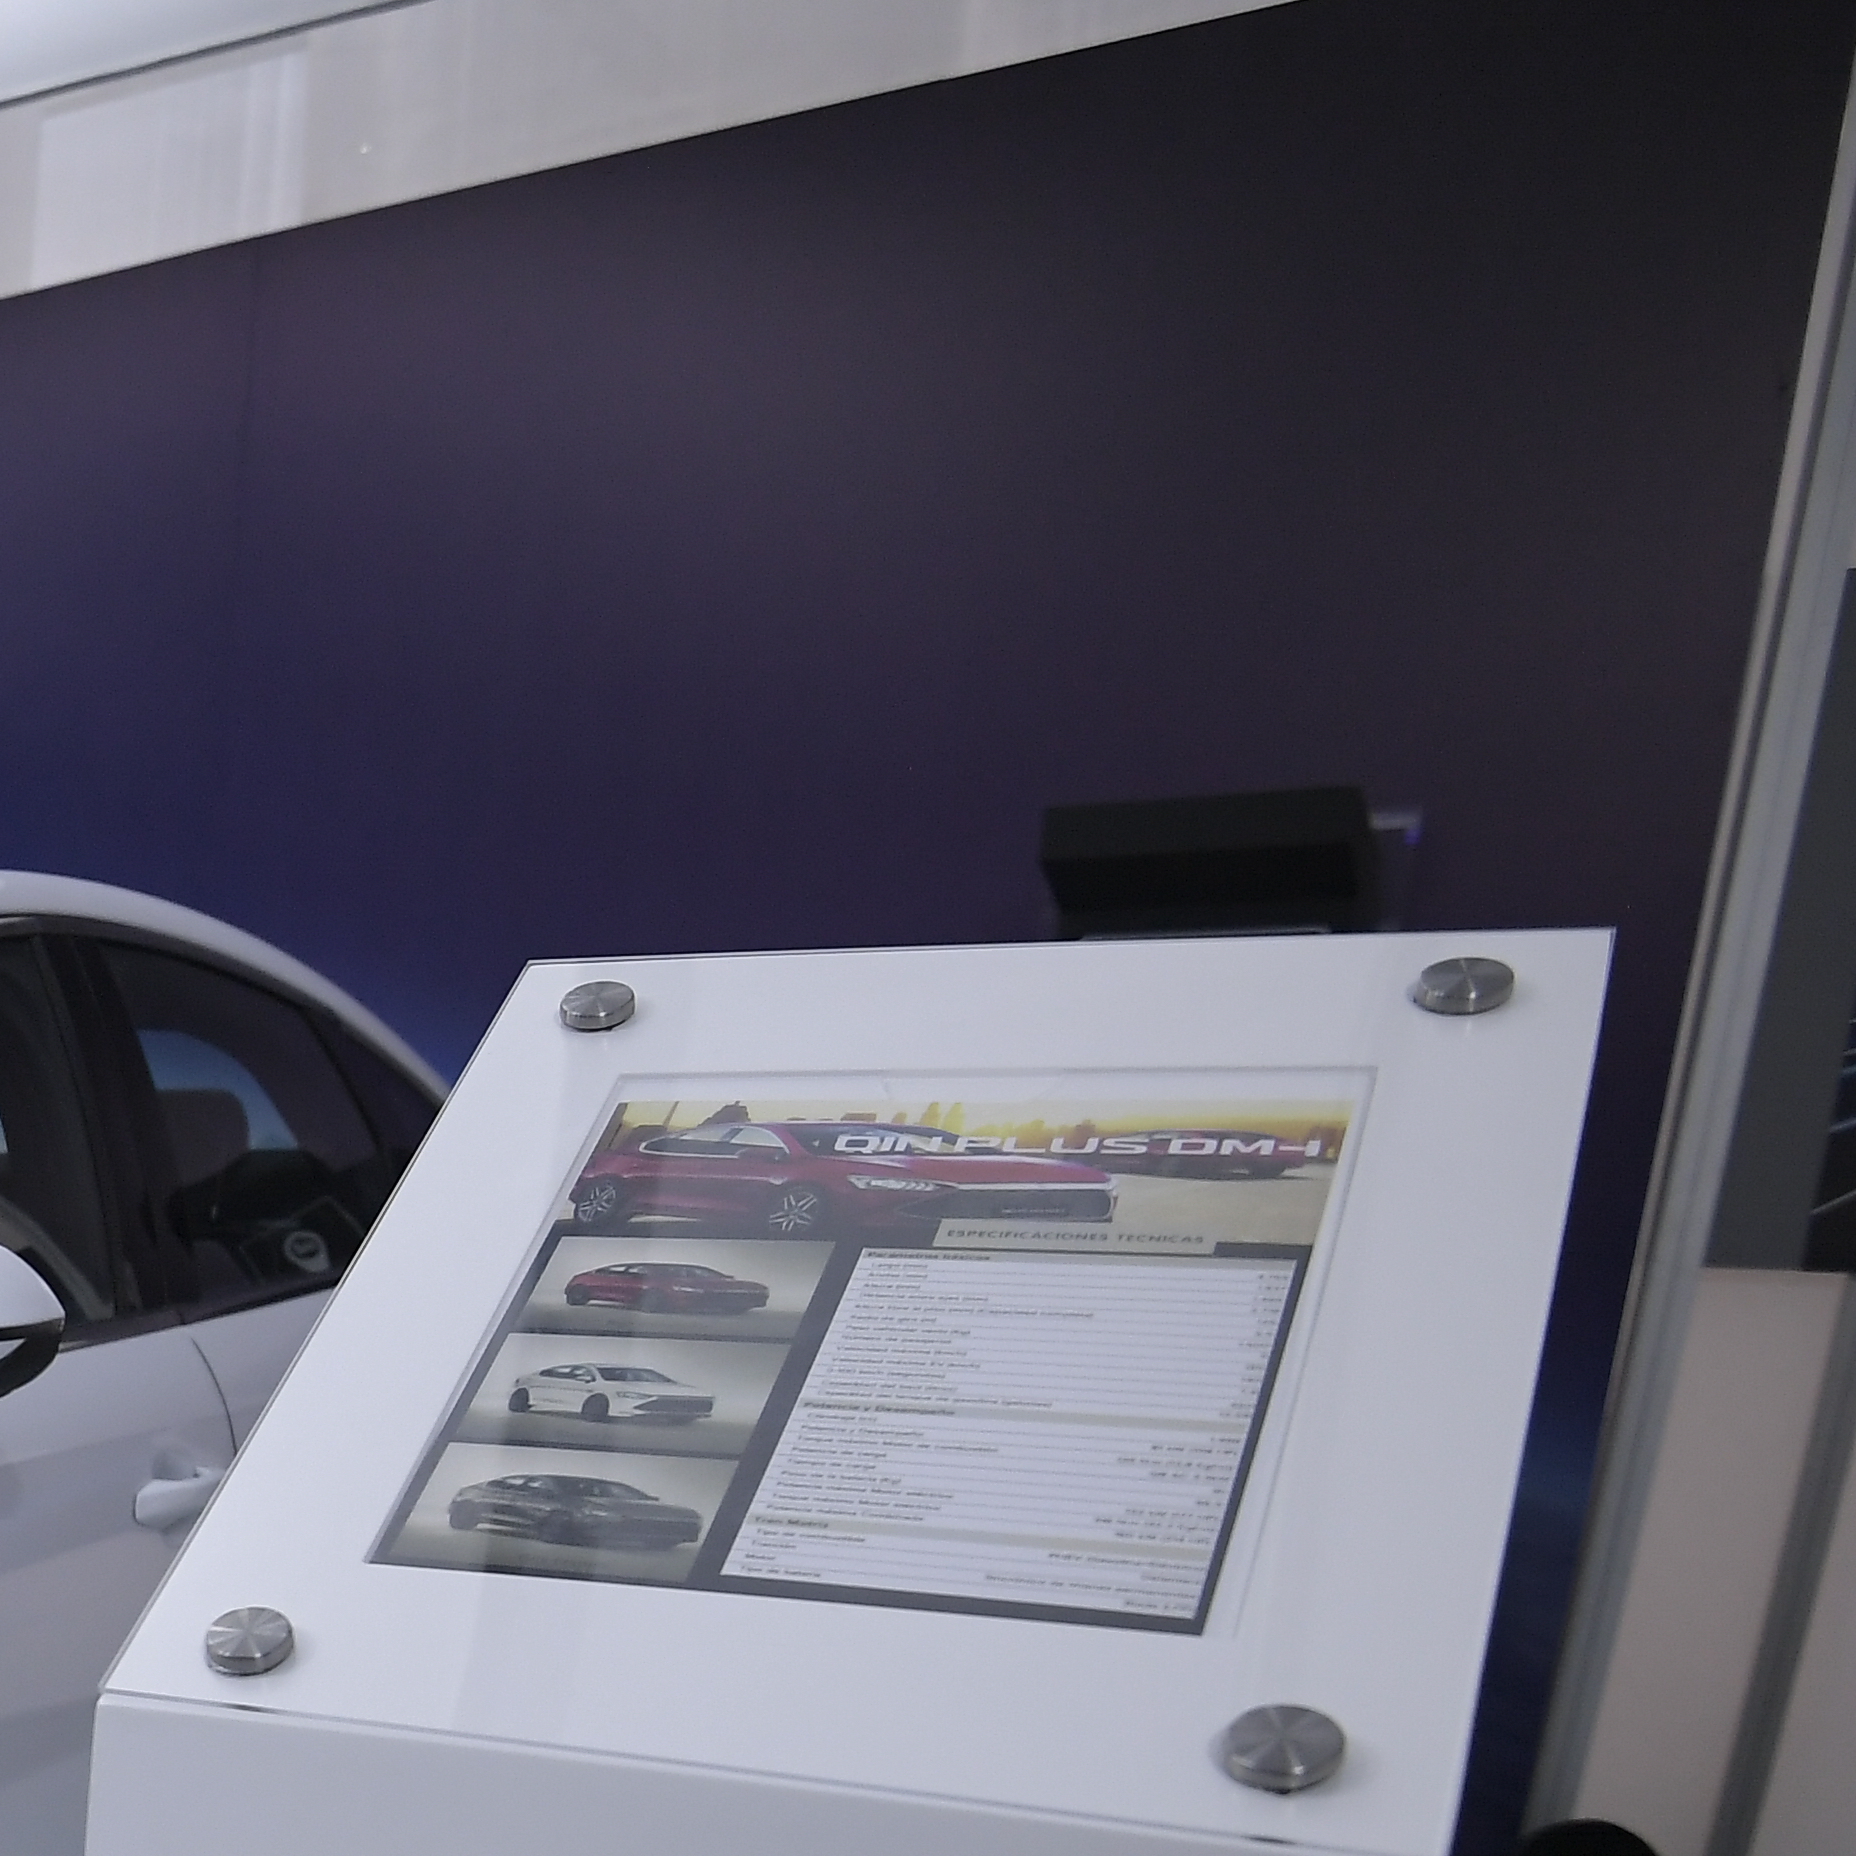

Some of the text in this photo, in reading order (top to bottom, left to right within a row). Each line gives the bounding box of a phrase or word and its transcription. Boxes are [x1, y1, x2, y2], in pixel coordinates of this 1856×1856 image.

[834, 1133, 945, 1155] QIN
[955, 1134, 1153, 1156] PLUS
[946, 1229, 1108, 1242] ESPECIFICACIONES
